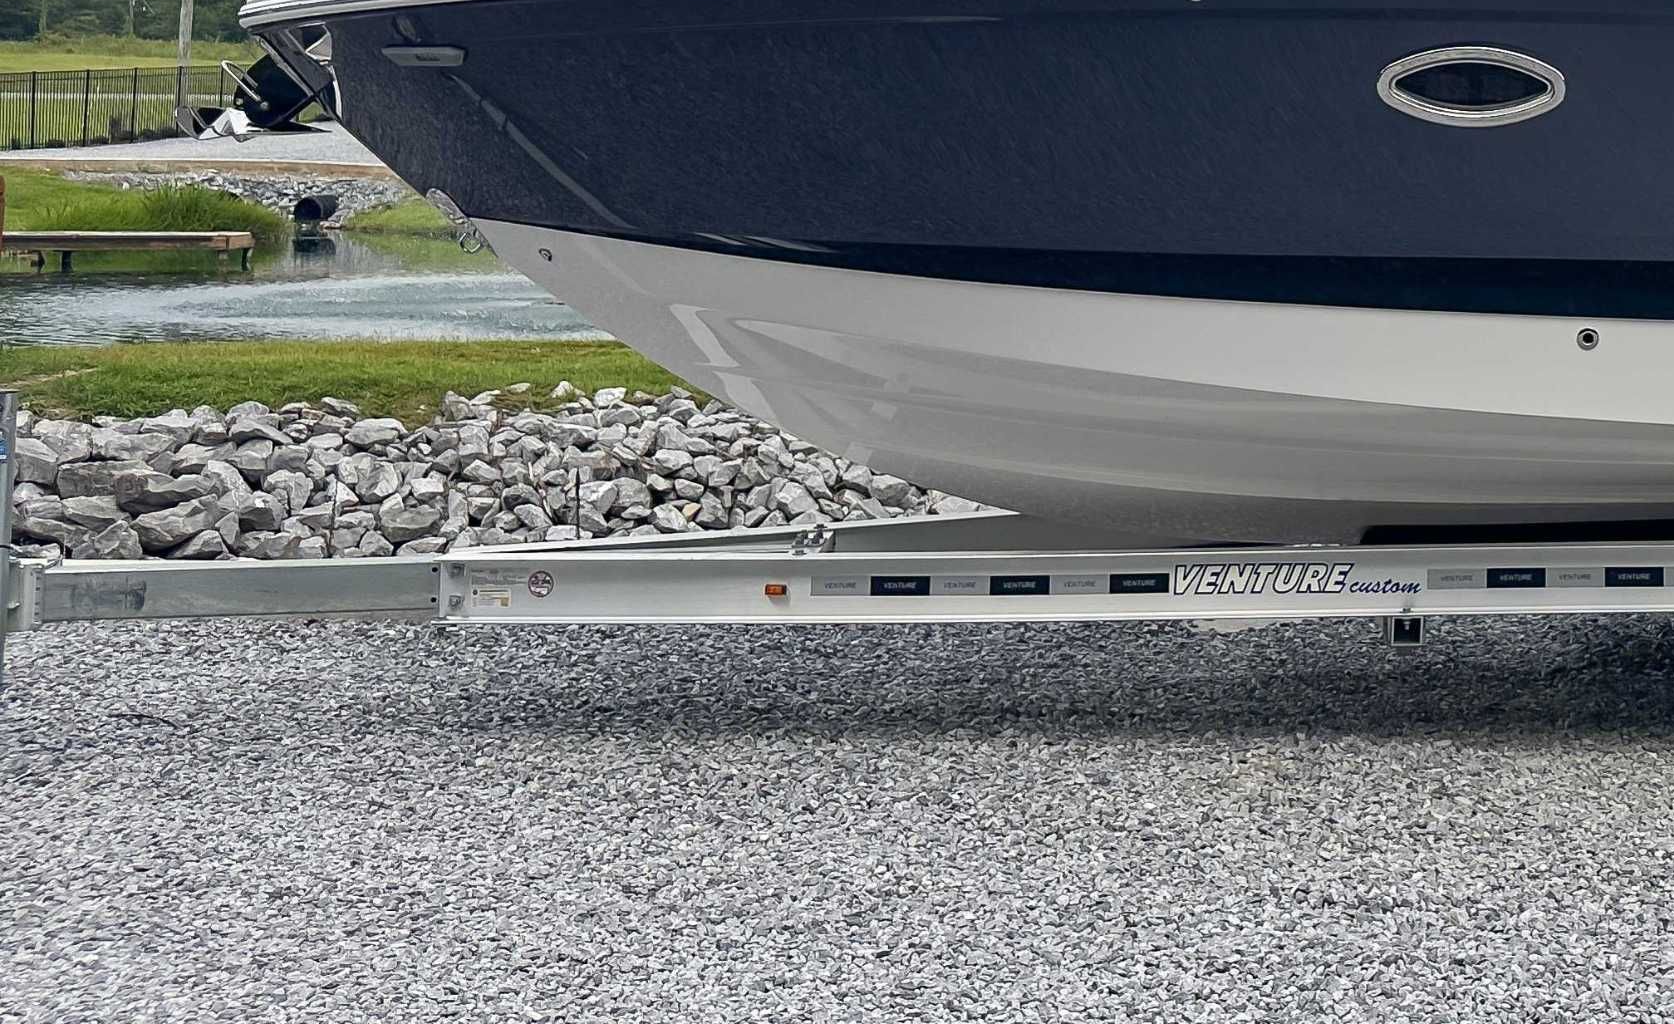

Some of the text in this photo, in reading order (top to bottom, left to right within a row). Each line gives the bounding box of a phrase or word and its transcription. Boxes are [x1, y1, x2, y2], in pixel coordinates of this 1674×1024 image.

[1122, 579, 1156, 587] VENTURE
[1173, 562, 1422, 595] VENTURE custom
[1002, 580, 1037, 589] VENTURE
